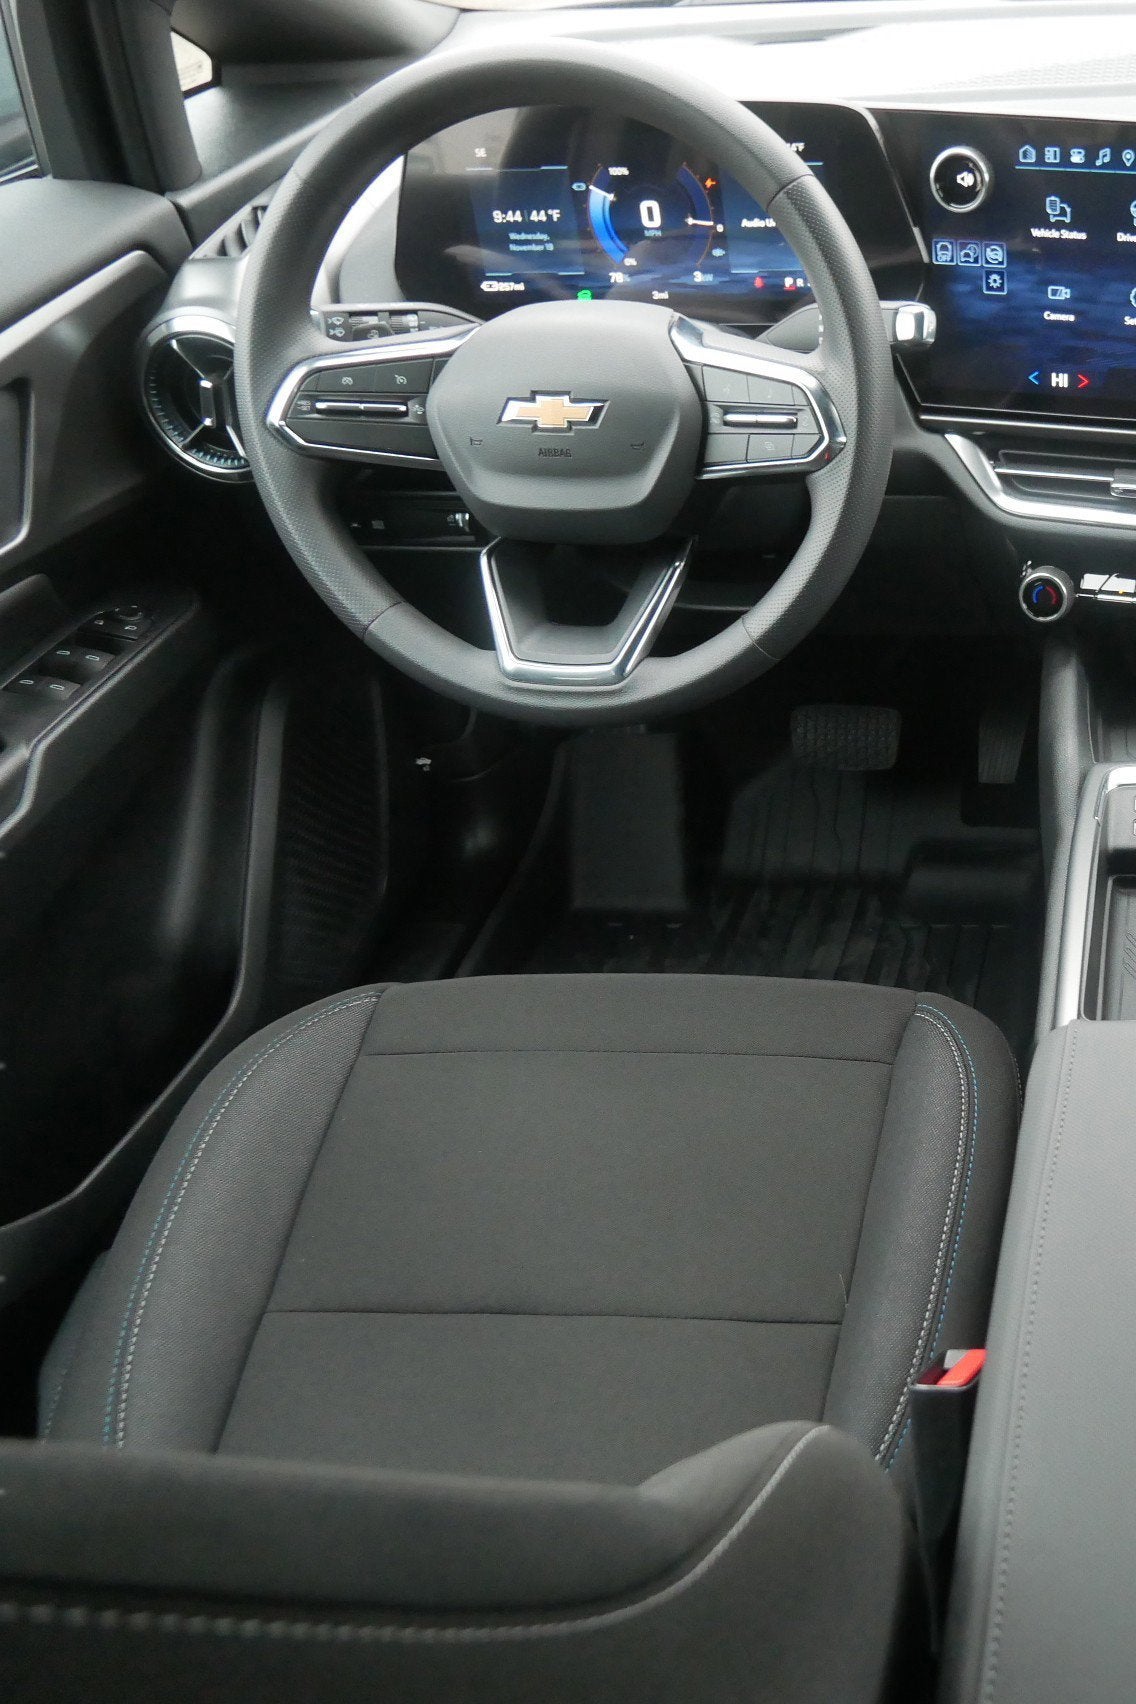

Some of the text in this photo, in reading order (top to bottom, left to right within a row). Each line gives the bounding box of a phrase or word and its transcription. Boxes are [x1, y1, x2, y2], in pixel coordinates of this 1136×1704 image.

[608, 167, 629, 176] 100%
[492, 210, 522, 223] 9:44
[640, 200, 661, 228] 0
[741, 218, 765, 228] Audio
[644, 229, 662, 237] MPH
[716, 224, 724, 233] 0
[1030, 227, 1088, 240] Vehicle Status
[508, 243, 544, 251] November
[784, 277, 794, 287] P
[796, 277, 804, 287] R
[1043, 311, 1075, 322] Camera
[1051, 372, 1069, 388] HI
[538, 448, 572, 458] AIRBAG
